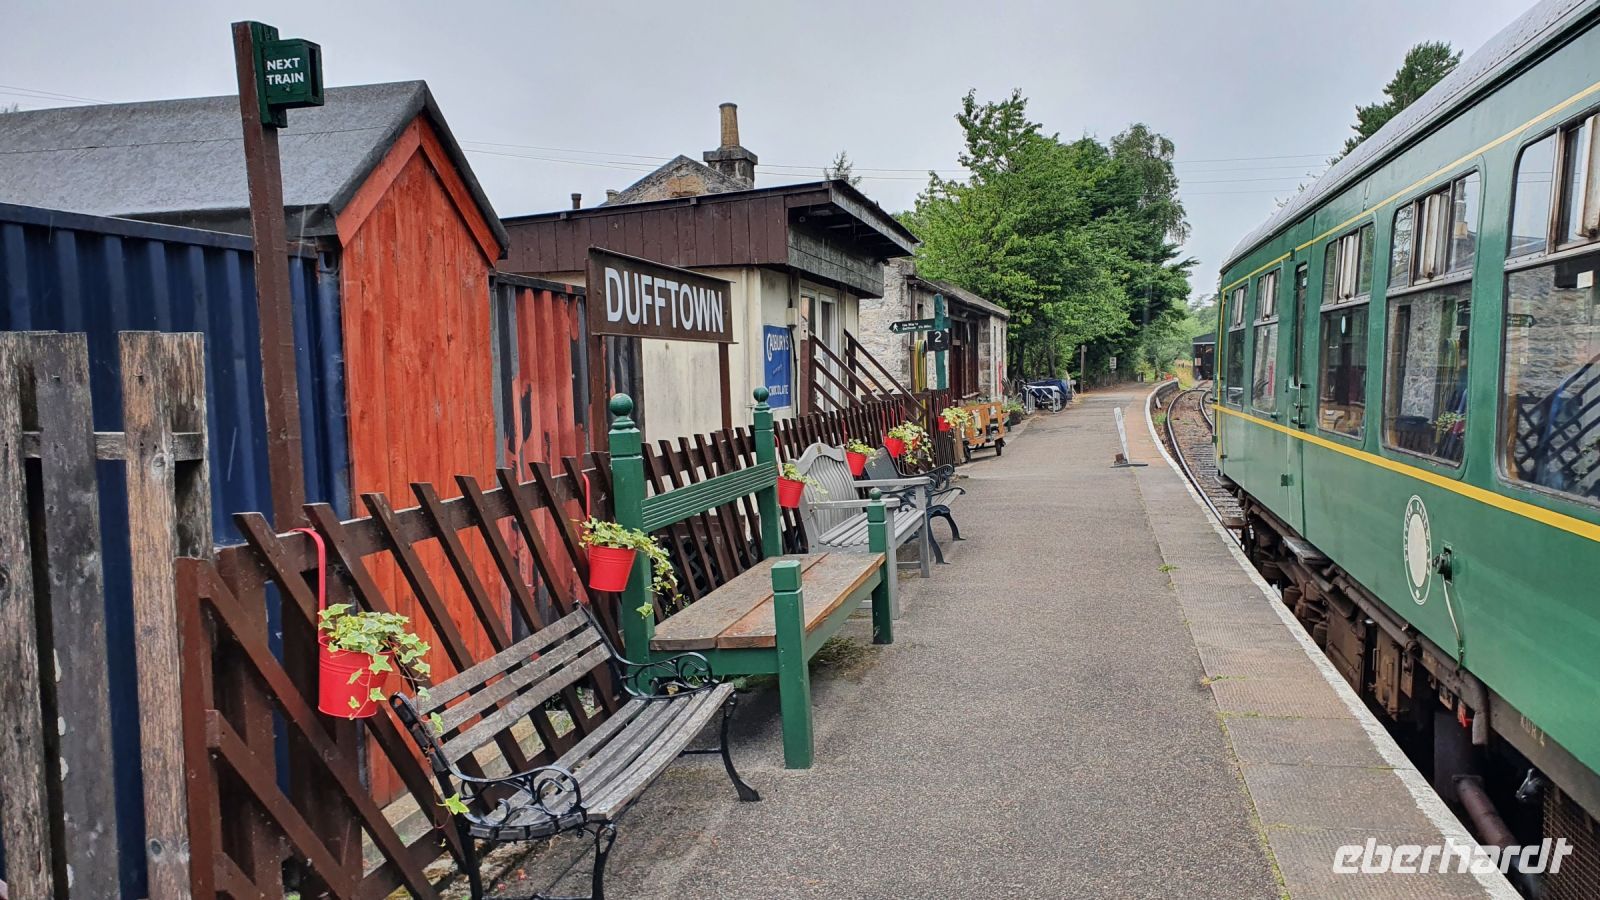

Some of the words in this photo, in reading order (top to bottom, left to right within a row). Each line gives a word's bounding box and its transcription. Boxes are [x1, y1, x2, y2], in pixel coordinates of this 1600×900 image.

[267, 57, 300, 70] NEXT
[267, 72, 304, 85] TRAIN
[605, 267, 724, 333] DUFFTOWN
[934, 331, 942, 343] 2
